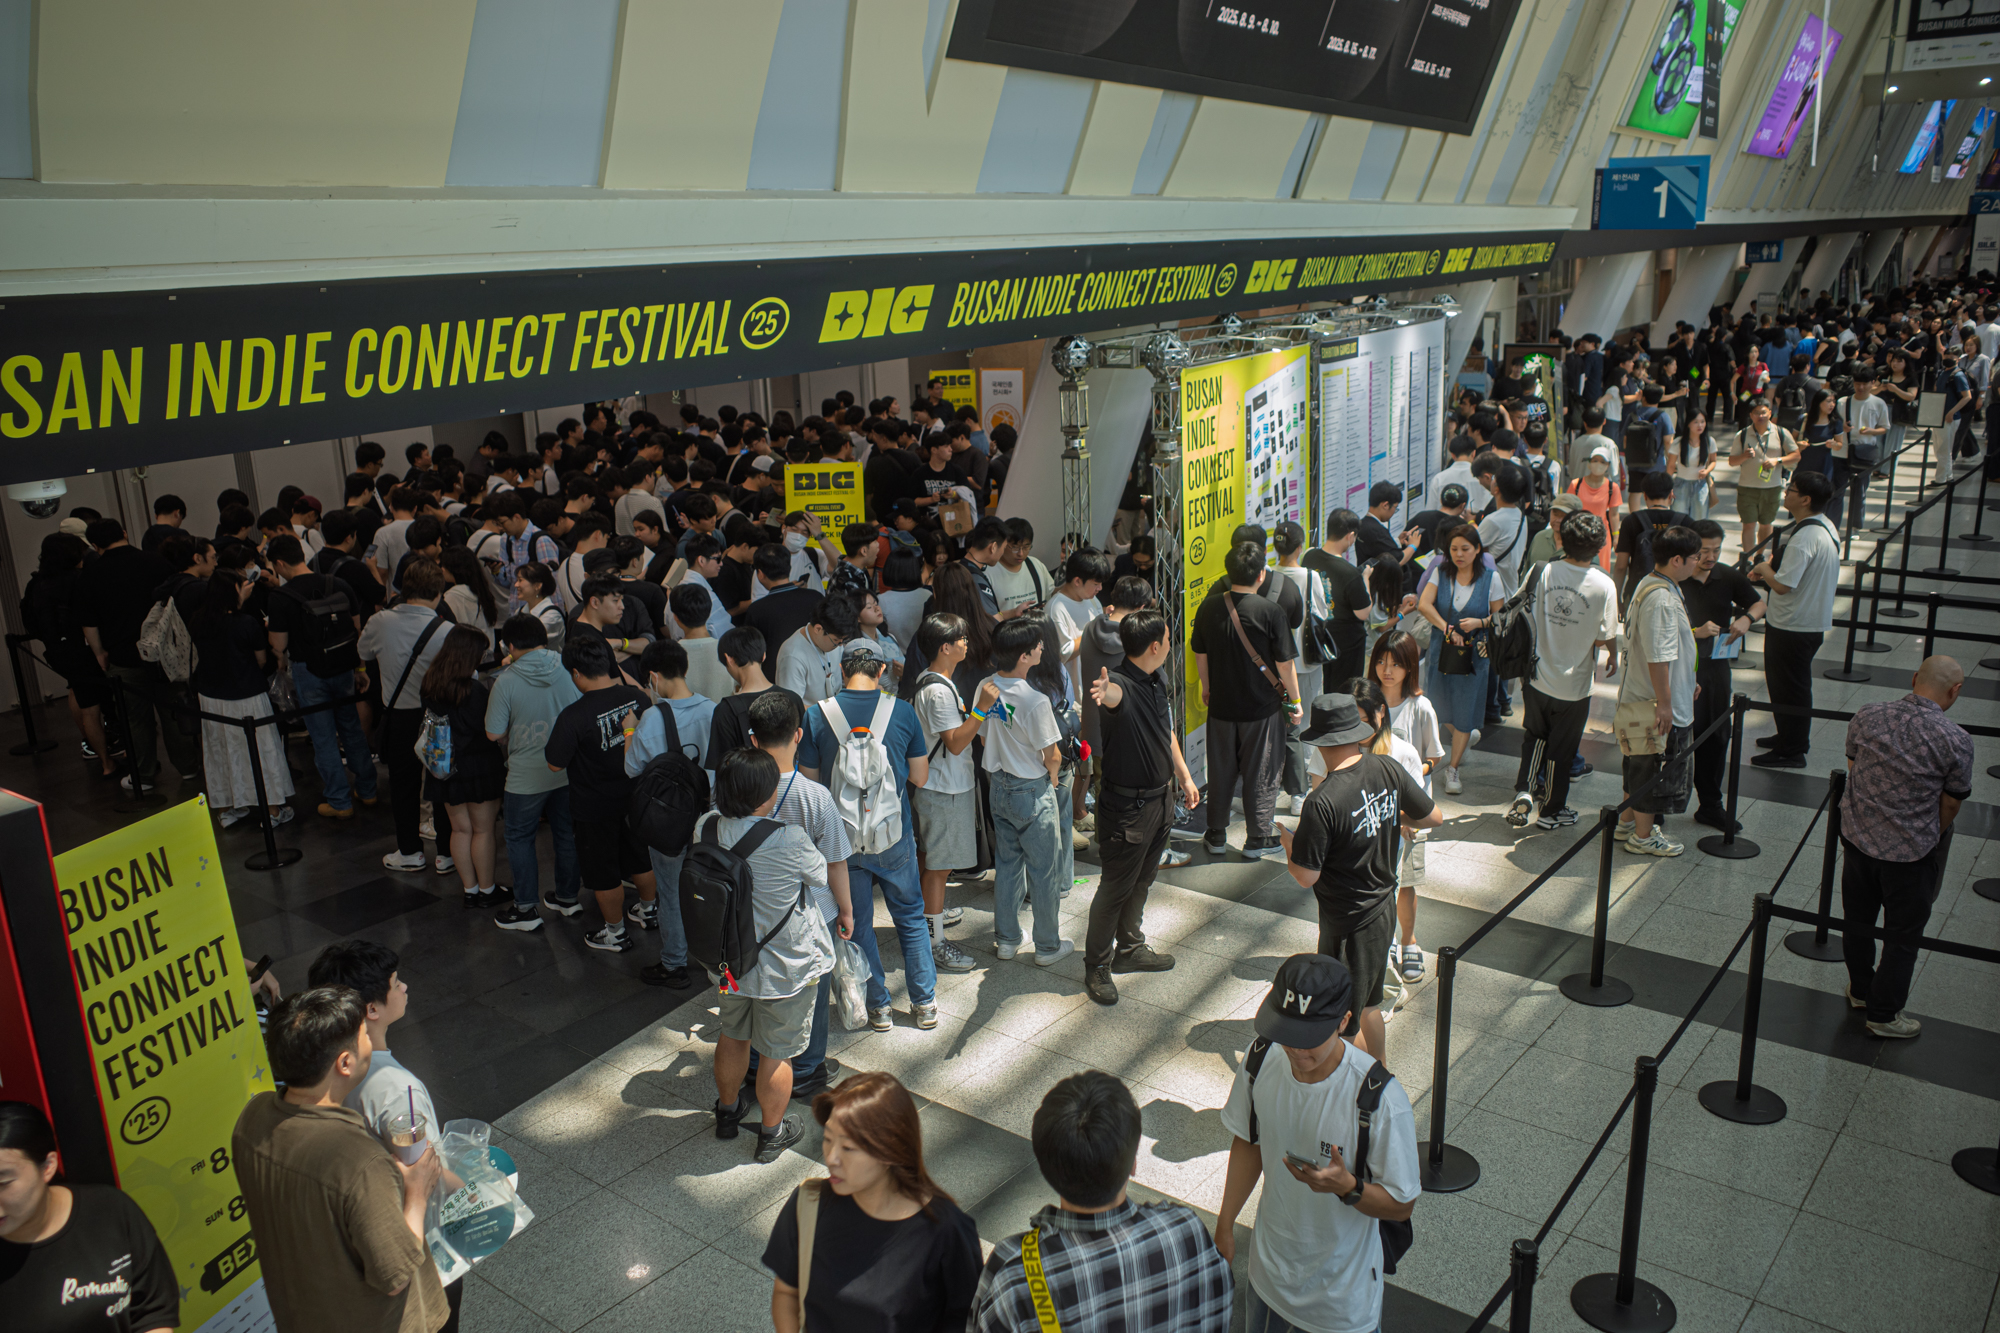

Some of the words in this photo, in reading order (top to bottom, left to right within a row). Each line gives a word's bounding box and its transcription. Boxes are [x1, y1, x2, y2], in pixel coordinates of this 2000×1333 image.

[1917, 20, 1943, 32] BUSAN
[1944, 17, 1966, 29] INDIE
[1613, 183, 1628, 191] Hall
[1653, 180, 1669, 218] 1
[1244, 258, 1298, 294] BIC
[1298, 256, 1332, 288] BUSAN
[1331, 254, 1357, 285] INDIE
[1357, 252, 1398, 283] CONNECT
[1396, 250, 1431, 280] FESTIVAL
[818, 284, 935, 343] BIC
[947, 276, 1020, 328] BUSAN
[1022, 272, 1083, 319] INDIE
[1084, 267, 1158, 312] CONNECT
[1154, 263, 1217, 306] FESTIVAL
[0, 346, 143, 438] SAN
[166, 332, 332, 420] INDIE
[345, 312, 566, 398] CONNECT
[569, 300, 731, 372] FESTIVAL
[1186, 375, 1222, 412] BUSAN
[1187, 416, 1215, 452] INDIE
[794, 471, 855, 490] BIC
[1188, 448, 1235, 490] CONNECT
[1189, 486, 1234, 530] FESTIVAL
[59, 846, 173, 935] BUSAN
[72, 909, 168, 993] INDIE
[87, 934, 228, 1046] CONNECT
[102, 989, 244, 1101] FESTIVAL
[1321, 1141, 1343, 1151] DON
[190, 1159, 206, 1175] FRI
[204, 1208, 224, 1226] SUN
